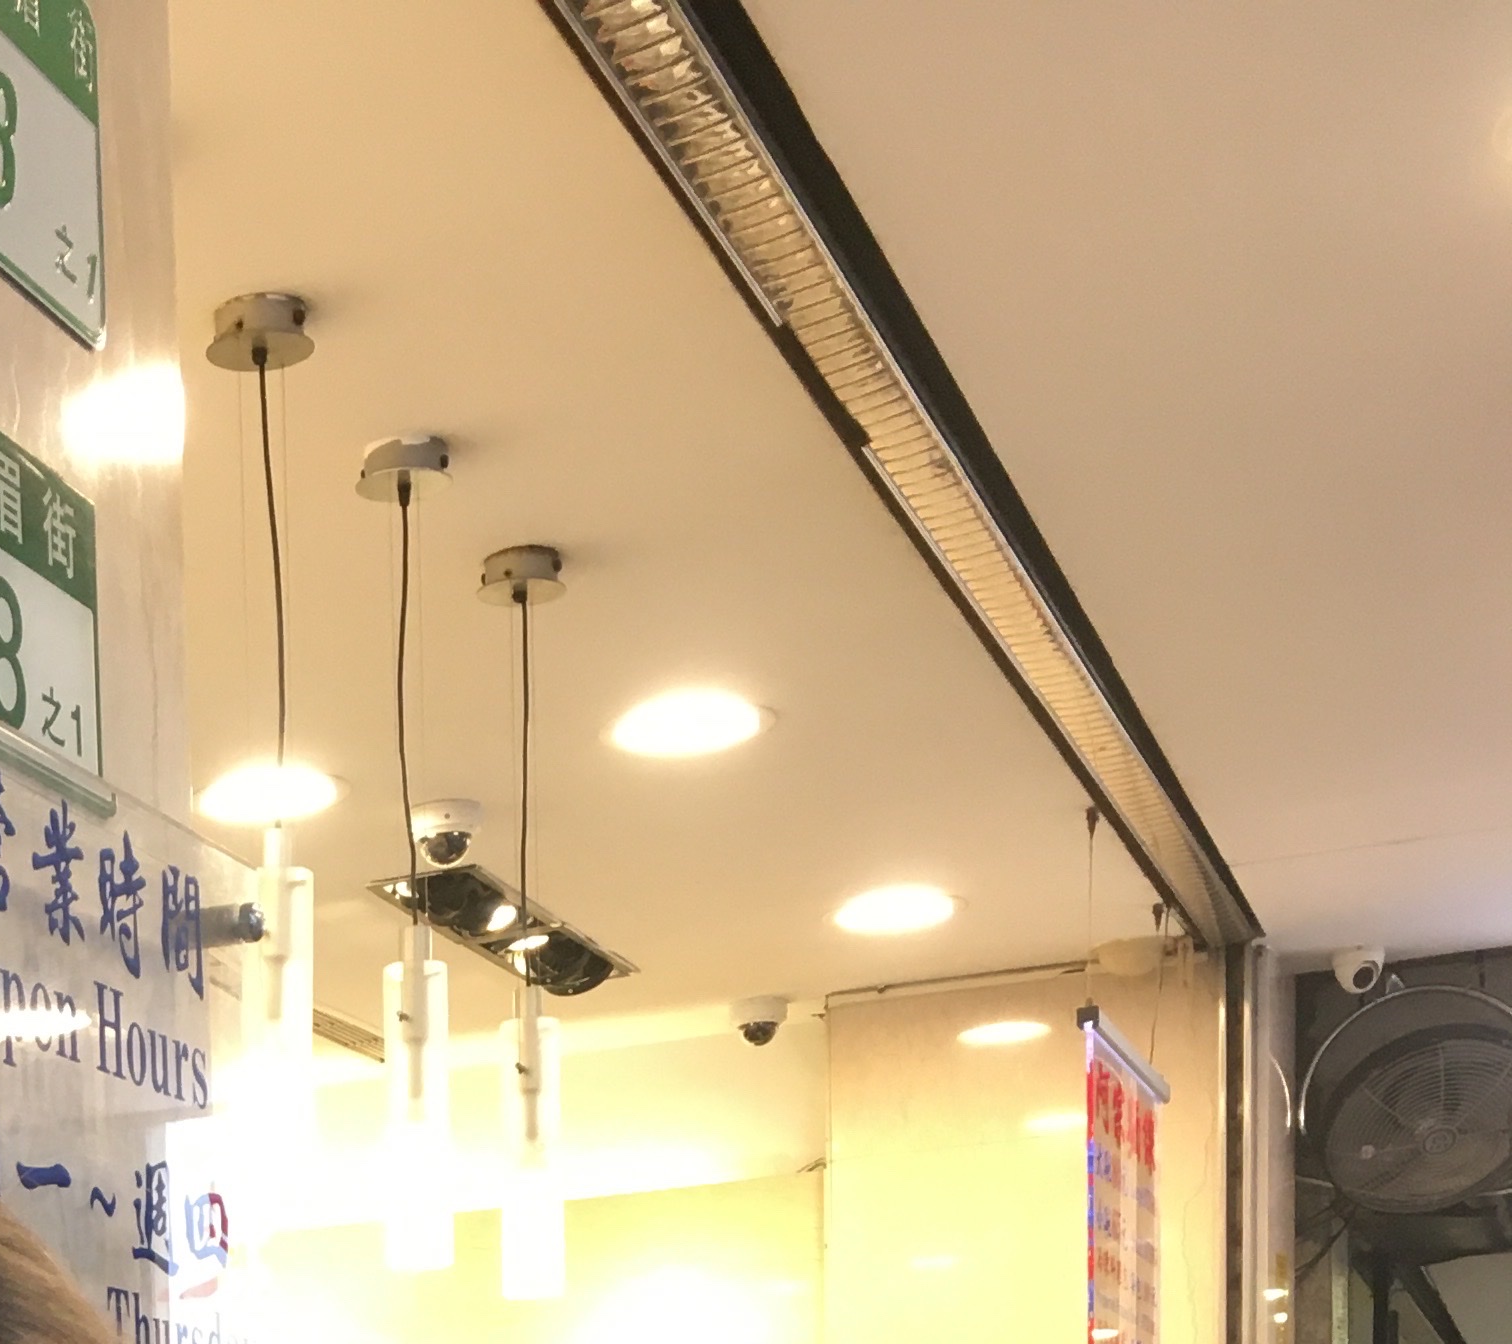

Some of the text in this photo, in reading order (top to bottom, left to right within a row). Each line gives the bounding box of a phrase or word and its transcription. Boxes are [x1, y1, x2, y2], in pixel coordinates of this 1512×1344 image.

[54, 225, 97, 304] 之1
[41, 687, 84, 758] 之1
[94, 980, 209, 1110] Hours
